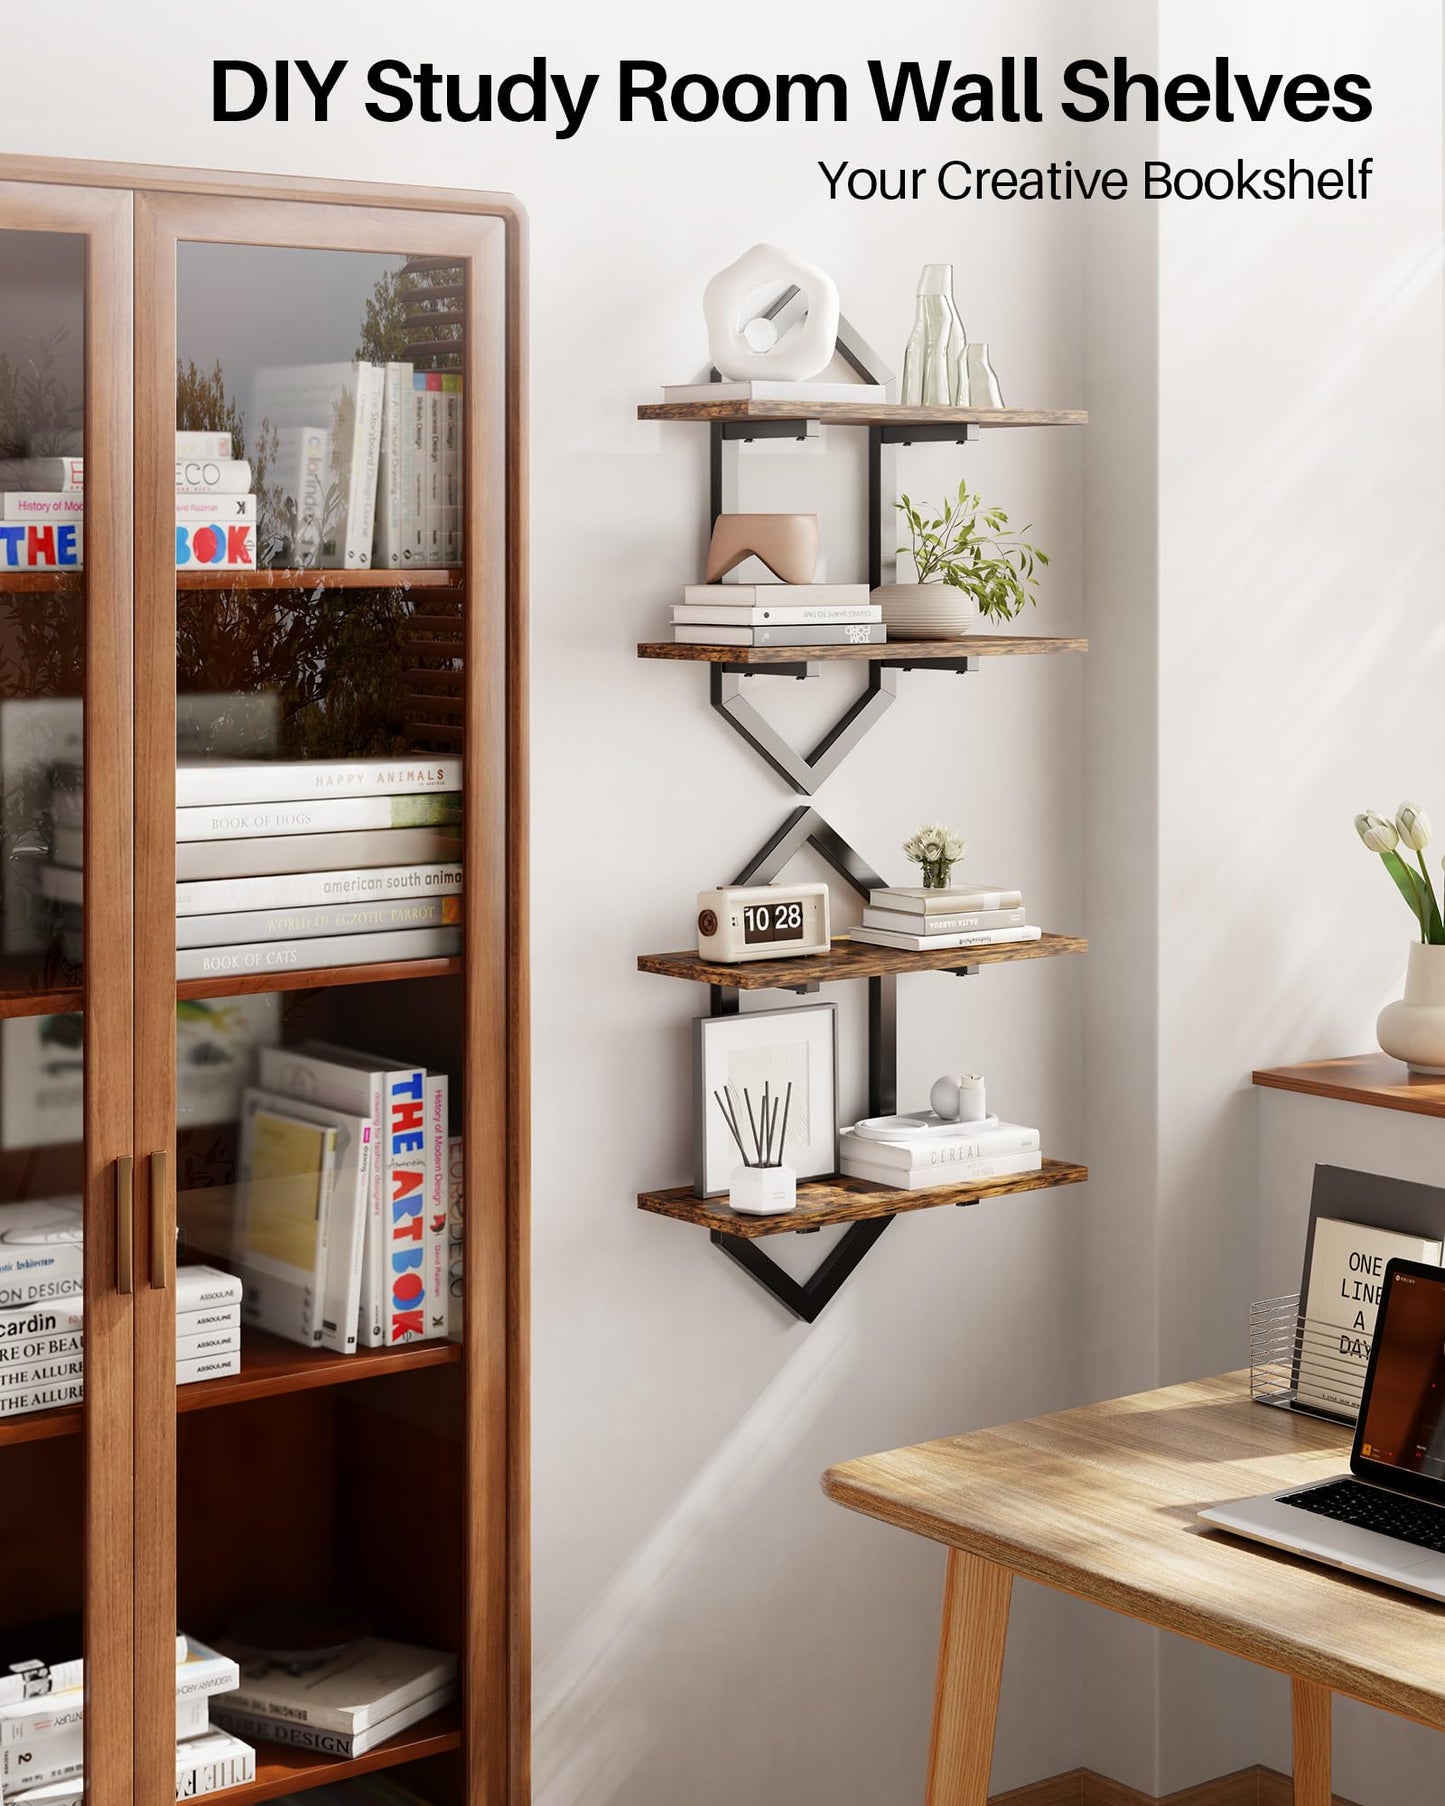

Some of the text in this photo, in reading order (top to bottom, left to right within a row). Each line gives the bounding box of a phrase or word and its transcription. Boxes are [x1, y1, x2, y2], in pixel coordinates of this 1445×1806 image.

[18, 501, 50, 513] History
[53, 501, 61, 511] of
[0, 525, 78, 566] THE
[850, 634, 871, 643] TOM
[315, 769, 444, 787] HAPPY ANIMALS
[211, 813, 312, 830] BOOK OF DOGS
[324, 876, 383, 894] american
[386, 872, 421, 889] south
[267, 906, 436, 932] WORLD OF EGZOTIC PARROT
[744, 903, 802, 933] 10 28
[203, 950, 297, 971] BOOK OF CATS
[392, 1073, 424, 1155] THE
[432, 1089, 443, 1206] History of Modern Design
[931, 1144, 981, 1165] CEREAL
[392, 1170, 424, 1241] ART
[434, 1245, 442, 1265] David
[1349, 1252, 1383, 1277] ONE
[0, 1280, 83, 1304] ON DESIGN
[200, 1289, 234, 1301] ASSOULINE
[1341, 1278, 1382, 1305] LINE
[197, 1314, 232, 1325] ASSOULINE
[1353, 1310, 1365, 1331] A
[23, 1341, 45, 1358] OF
[197, 1338, 232, 1349] ASSOULINE
[197, 1362, 232, 1373] ASSOULINE
[0, 1371, 28, 1386] THE
[0, 1395, 28, 1411] THE
[275, 1724, 350, 1754] DESIGN
[18, 1752, 32, 1765] 2
[204, 1757, 252, 1791] THE
